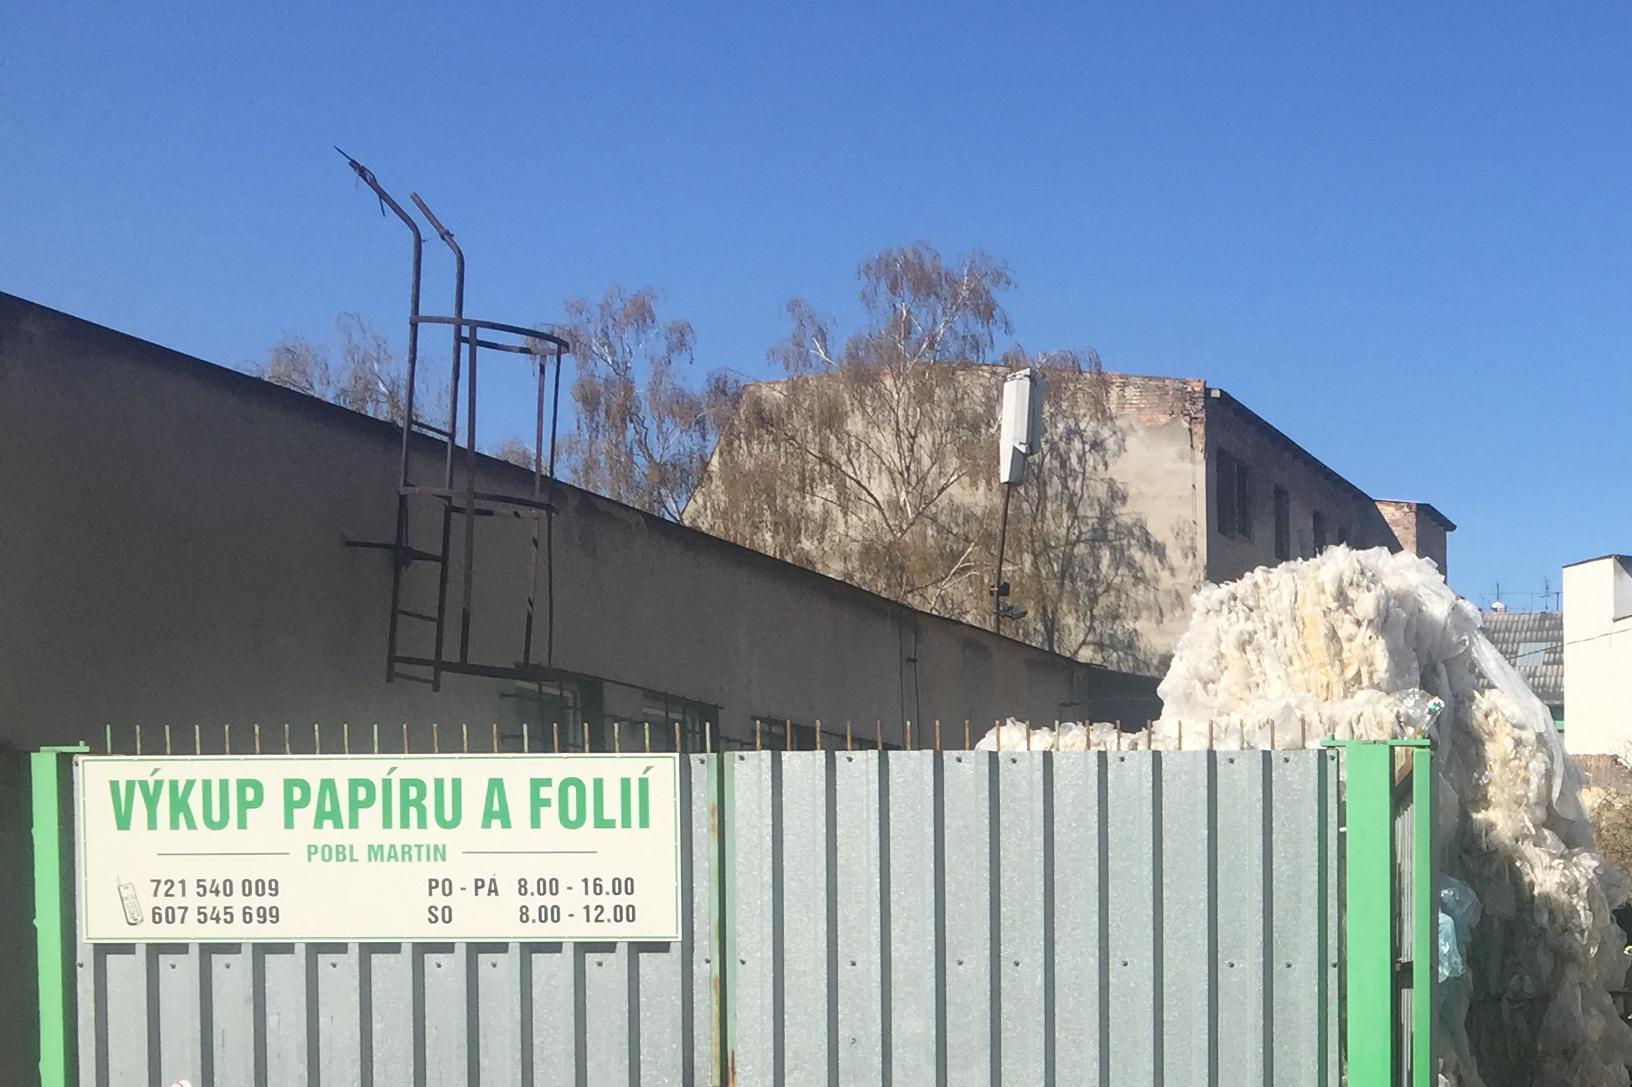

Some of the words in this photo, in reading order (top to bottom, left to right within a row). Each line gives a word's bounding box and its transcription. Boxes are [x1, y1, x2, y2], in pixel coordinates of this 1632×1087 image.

[109, 767, 265, 831] VÝKUP
[283, 766, 463, 830] PAPÍRU
[481, 777, 512, 829] A
[529, 765, 653, 829] FOLIÍ
[307, 844, 358, 863] POBL
[367, 844, 447, 862] MARTIN
[149, 878, 186, 898] 721
[196, 878, 234, 898] 540
[241, 878, 279, 898] 009
[428, 877, 453, 897] PO
[474, 873, 499, 897] PÁ
[517, 877, 560, 897] 8.00
[581, 876, 635, 896] 16.00
[151, 905, 188, 925] 607
[196, 905, 235, 925] 545
[242, 905, 280, 925] 699
[427, 905, 453, 924] SO
[519, 904, 561, 924] 8.00
[582, 904, 636, 924] 12.00
